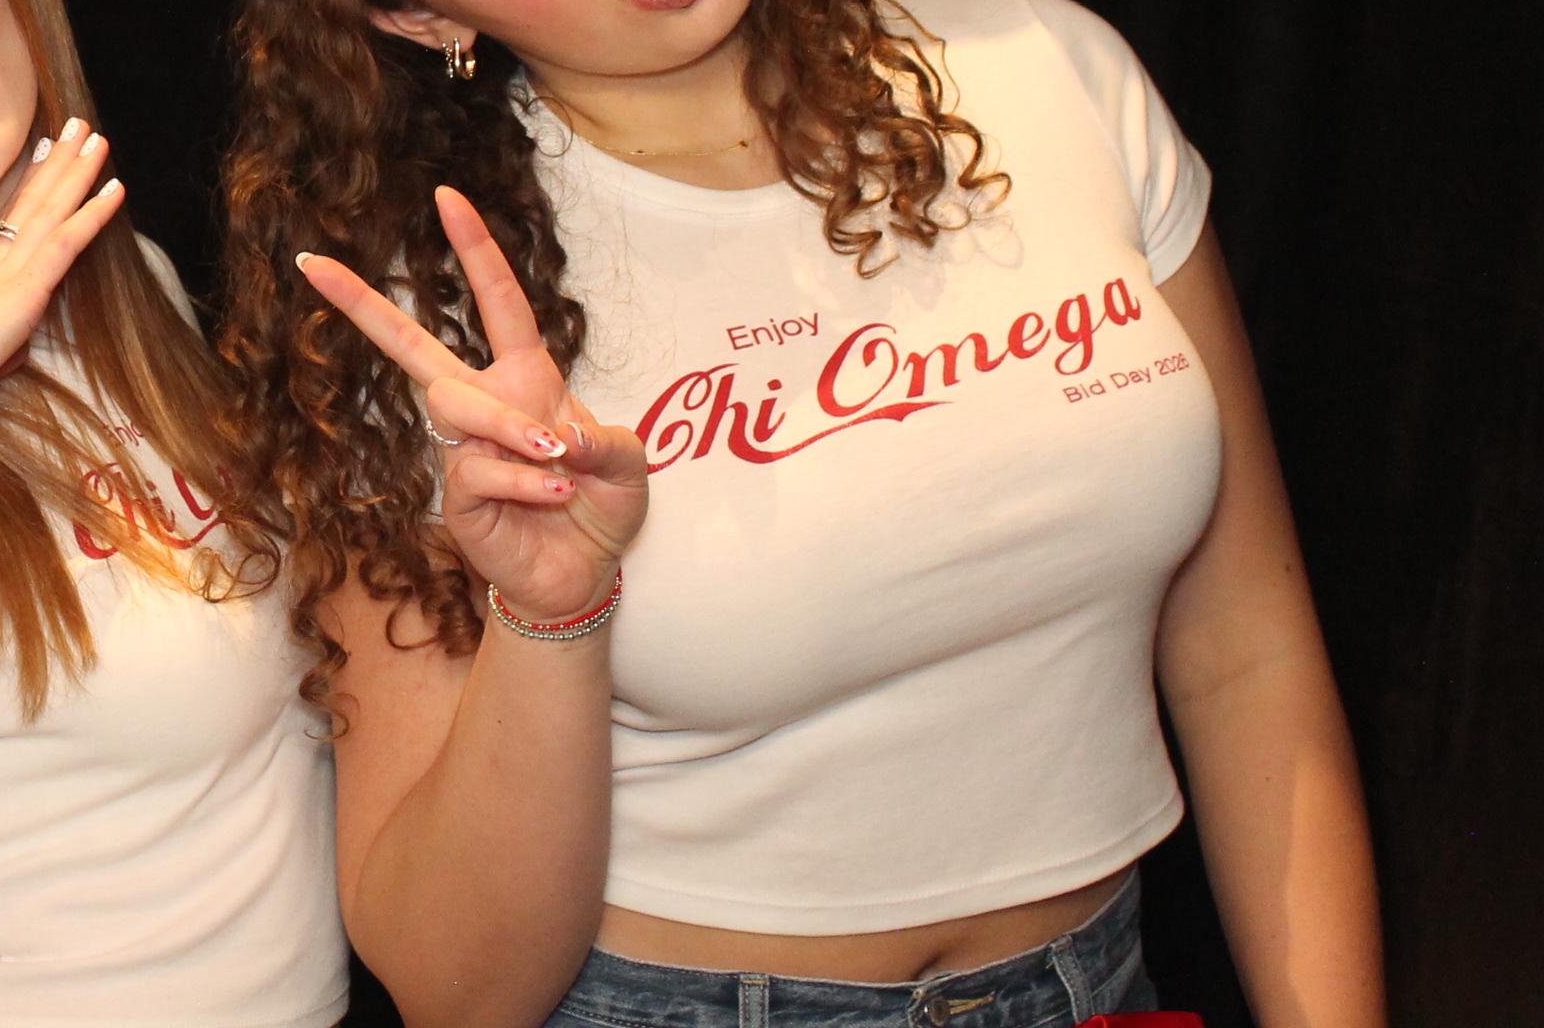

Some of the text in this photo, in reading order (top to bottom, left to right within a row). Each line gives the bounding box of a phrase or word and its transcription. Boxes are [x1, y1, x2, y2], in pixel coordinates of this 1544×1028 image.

[726, 312, 820, 351] Enjoy
[634, 277, 1142, 475] Chi Omega
[1062, 352, 1190, 403] Bid Day 2026
